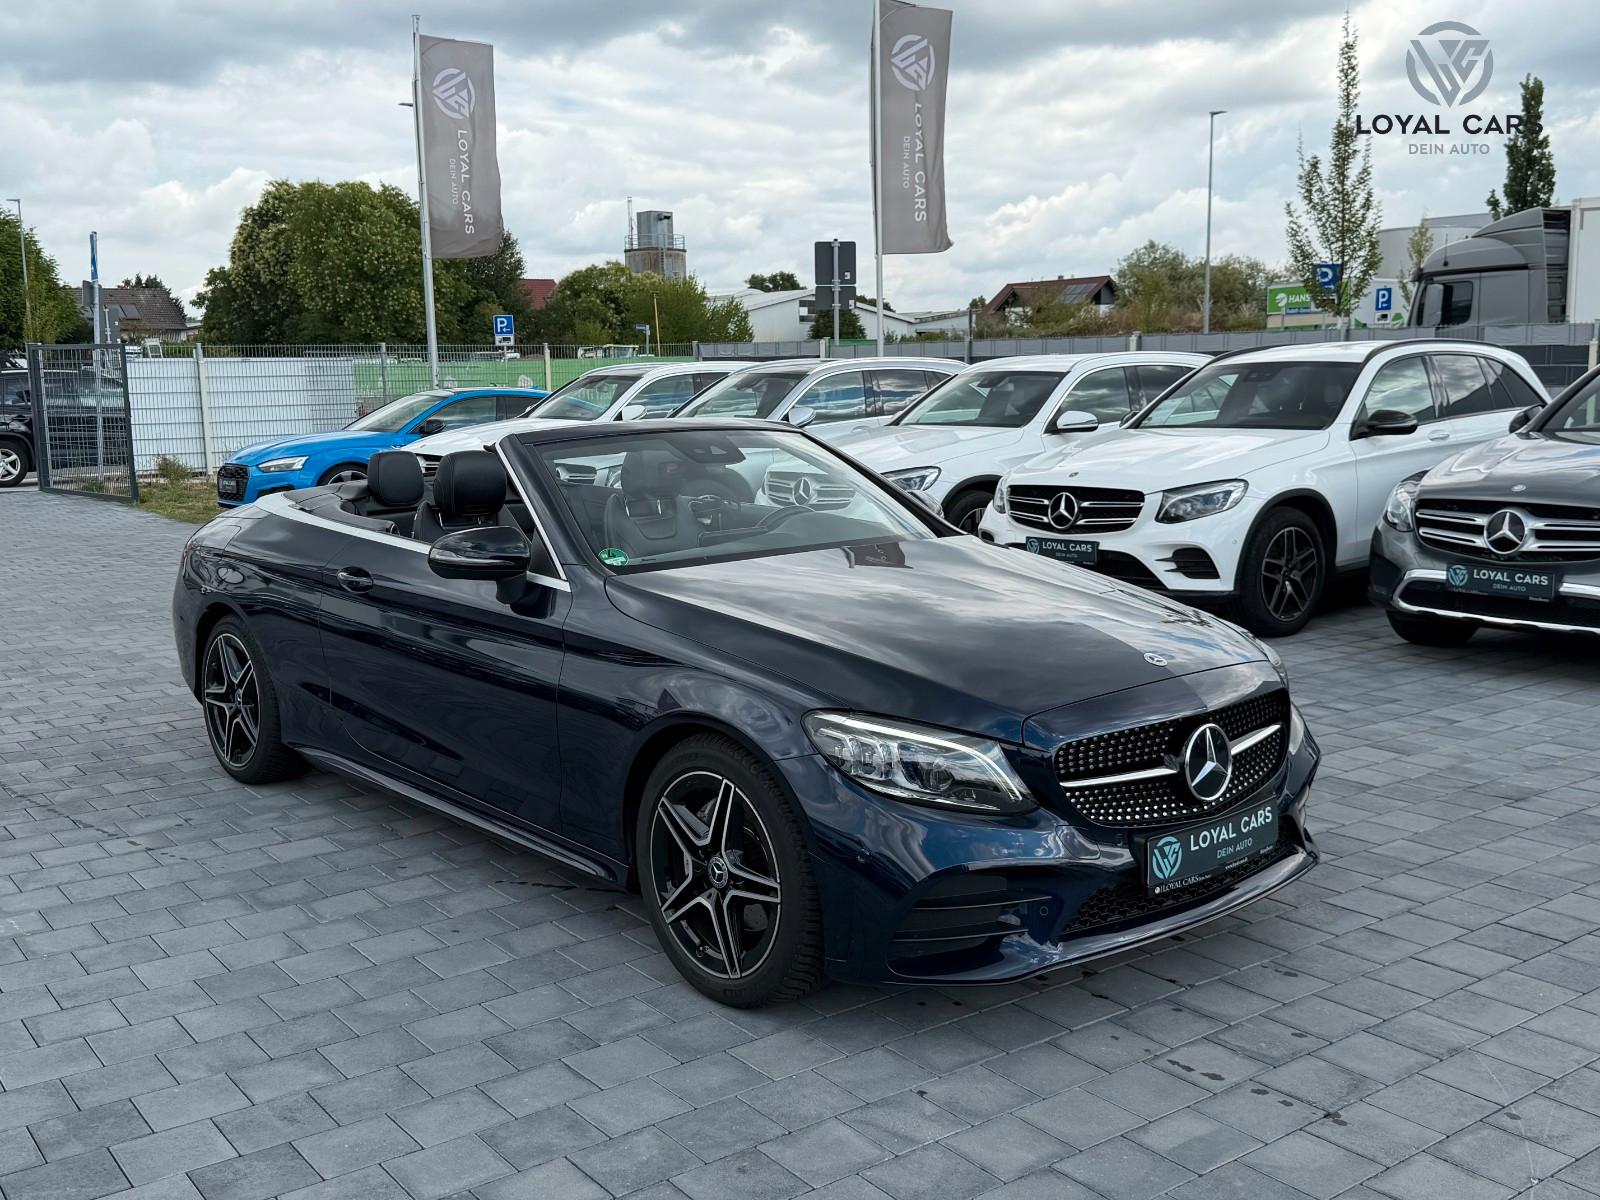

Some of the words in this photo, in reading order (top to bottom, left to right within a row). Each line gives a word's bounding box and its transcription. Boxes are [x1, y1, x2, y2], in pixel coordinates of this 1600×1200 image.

[914, 103, 924, 164] LOYAL
[457, 130, 470, 183] LOYAL
[449, 158, 457, 179] DEIN
[914, 171, 927, 222] CARS
[461, 190, 475, 234] CARS
[1379, 290, 1389, 308] P
[497, 317, 508, 333] P
[1042, 542, 1067, 551] LOYAL
[1069, 544, 1092, 552] CARS
[1473, 569, 1511, 582] LOYAL
[1514, 573, 1549, 586] CARS
[1190, 822, 1237, 851] LOYAL
[1240, 806, 1273, 833] CARS
[1216, 845, 1234, 859] DEIN
[1236, 838, 1253, 852] AUTO
[1162, 880, 1182, 892] LOYAL
[1182, 875, 1199, 886] CARS
